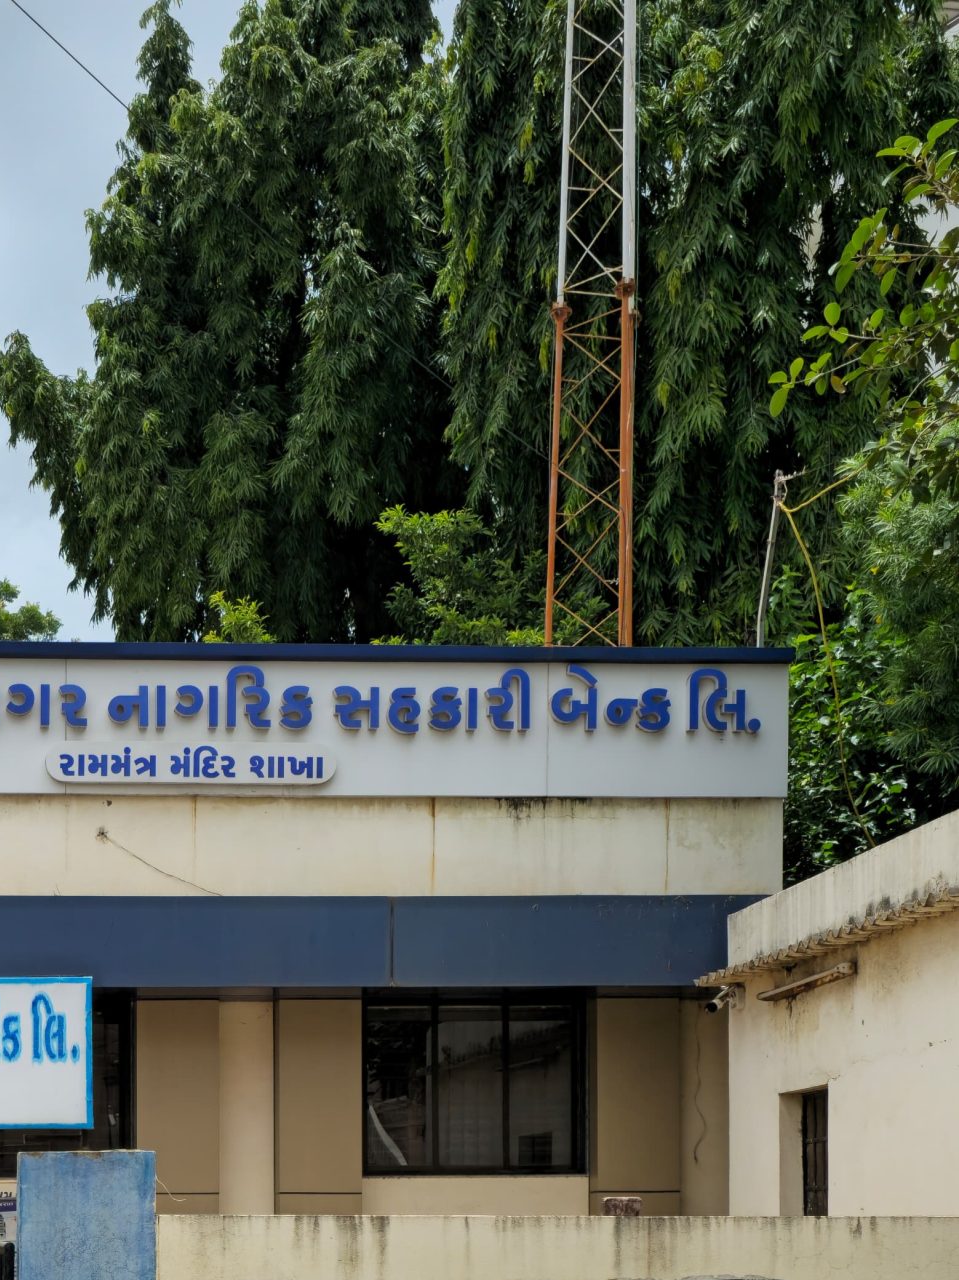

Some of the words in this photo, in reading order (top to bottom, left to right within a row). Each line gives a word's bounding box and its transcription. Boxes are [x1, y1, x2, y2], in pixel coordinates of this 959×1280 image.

[108, 665, 313, 730] નાગરિક
[333, 668, 530, 734] સહકારી
[549, 664, 671, 733] બેન્ક
[686, 669, 761, 734] લિ.
[59, 747, 157, 778] રામમંત્ર
[170, 745, 236, 779] મંદિર
[249, 755, 324, 780] શાખા
[31, 992, 81, 1063] લિ.
